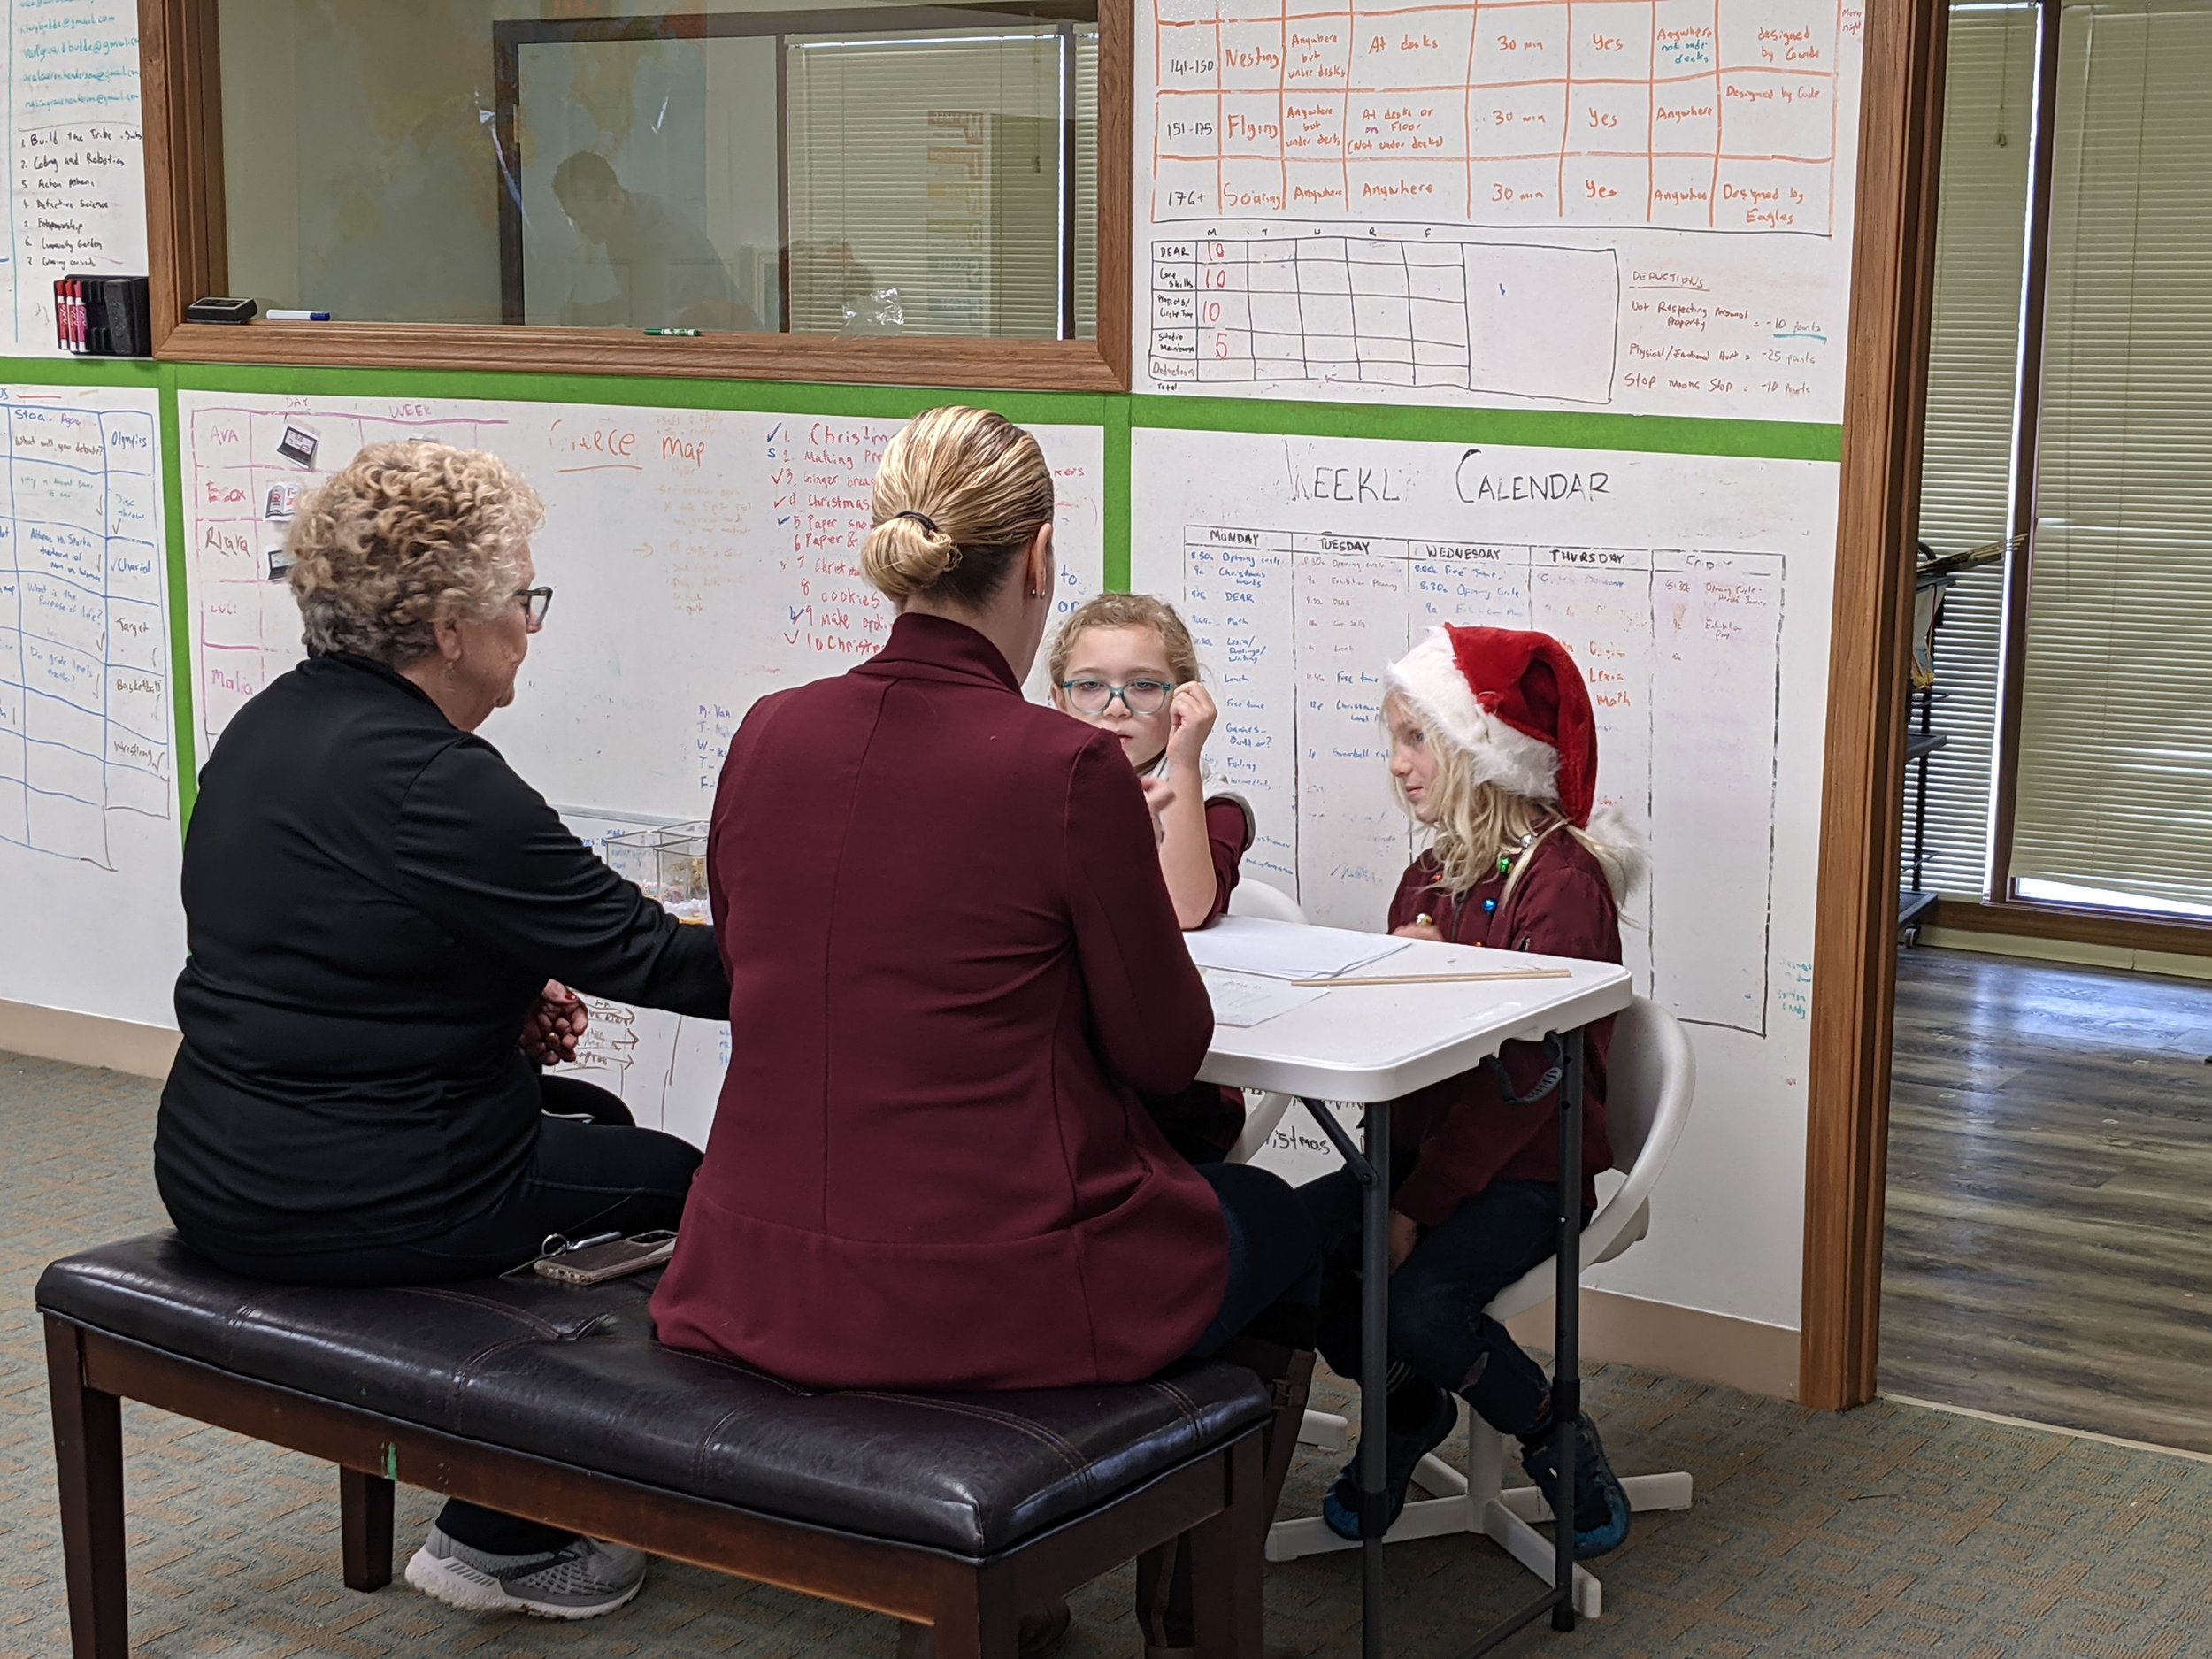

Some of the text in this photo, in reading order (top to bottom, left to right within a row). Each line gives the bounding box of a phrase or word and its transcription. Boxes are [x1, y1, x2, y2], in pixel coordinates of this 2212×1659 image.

[1291, 33, 1338, 49] Anywhere
[1592, 32, 1624, 52] Yes
[1656, 26, 1713, 42] Anywhere
[1757, 26, 1811, 47] designed
[1368, 34, 1439, 55] At desks
[1497, 38, 1544, 51] 30 min
[1662, 42, 1679, 51] not
[1225, 48, 1279, 70] Nesting
[1302, 50, 1320, 63] but
[1761, 45, 1775, 63] by
[1170, 58, 1214, 73] 141-150
[1780, 87, 1793, 103] by
[1286, 105, 1333, 119] Anywhere
[1362, 108, 1376, 121] At
[1420, 107, 1433, 118] or
[1493, 110, 1546, 124] 30 min
[1588, 106, 1618, 128] Yes
[1656, 105, 1713, 122] Anywhere
[1166, 119, 1213, 138] 151-175
[1227, 112, 1279, 140] Flying
[1302, 120, 1322, 132] but
[1364, 121, 1421, 134] on Floor
[65, 152, 79, 165] and
[1222, 181, 1281, 211] Soaring
[1363, 181, 1434, 202] Anywhere
[1491, 184, 1544, 202] 30 min
[1585, 179, 1618, 198] Yes
[1789, 188, 1805, 204] by
[81, 199, 108, 209] Science
[1168, 189, 1206, 207] 176+
[1745, 209, 1794, 227] Eagles
[1369, 227, 1377, 237] R
[1425, 228, 1432, 237] F
[1160, 246, 1190, 257] DEAR
[1205, 268, 1226, 289] 10
[1202, 301, 1221, 323] 10
[1630, 301, 1649, 312] Not
[1656, 301, 1708, 319] Respecting
[1667, 317, 1706, 332] Property
[1766, 317, 1786, 329] -10
[1215, 332, 1228, 359] 5
[1762, 349, 1782, 361] -25
[1624, 372, 1656, 388] Stop
[1708, 377, 1732, 393] Stop
[1761, 381, 1778, 393] -10
[14, 409, 46, 421] Stoa
[287, 397, 431, 419] DAY WEEK
[58, 443, 71, 452] you
[111, 431, 147, 450] Olympics
[804, 449, 854, 471] Making
[808, 494, 871, 511] Christmas
[808, 515, 838, 532] Paper
[805, 533, 843, 548] Paper
[1210, 530, 1259, 547] MONDAY
[1318, 538, 1370, 555] TUESDAY
[1425, 544, 1502, 561] WEDNESDAY
[1550, 549, 1625, 565] THURSDAY
[118, 558, 151, 574] Chariot
[1218, 567, 1266, 578] Christmas
[1060, 564, 1077, 586] to
[821, 588, 880, 609] cookies
[1225, 592, 1255, 604] DEAR
[115, 617, 149, 637] Target
[1227, 617, 1248, 626] Math
[1337, 671, 1354, 684] Free
[117, 679, 161, 694] Basketball
[1226, 698, 1242, 708] Free
[1596, 691, 1631, 708] Math
[114, 741, 153, 765] Wrestling
